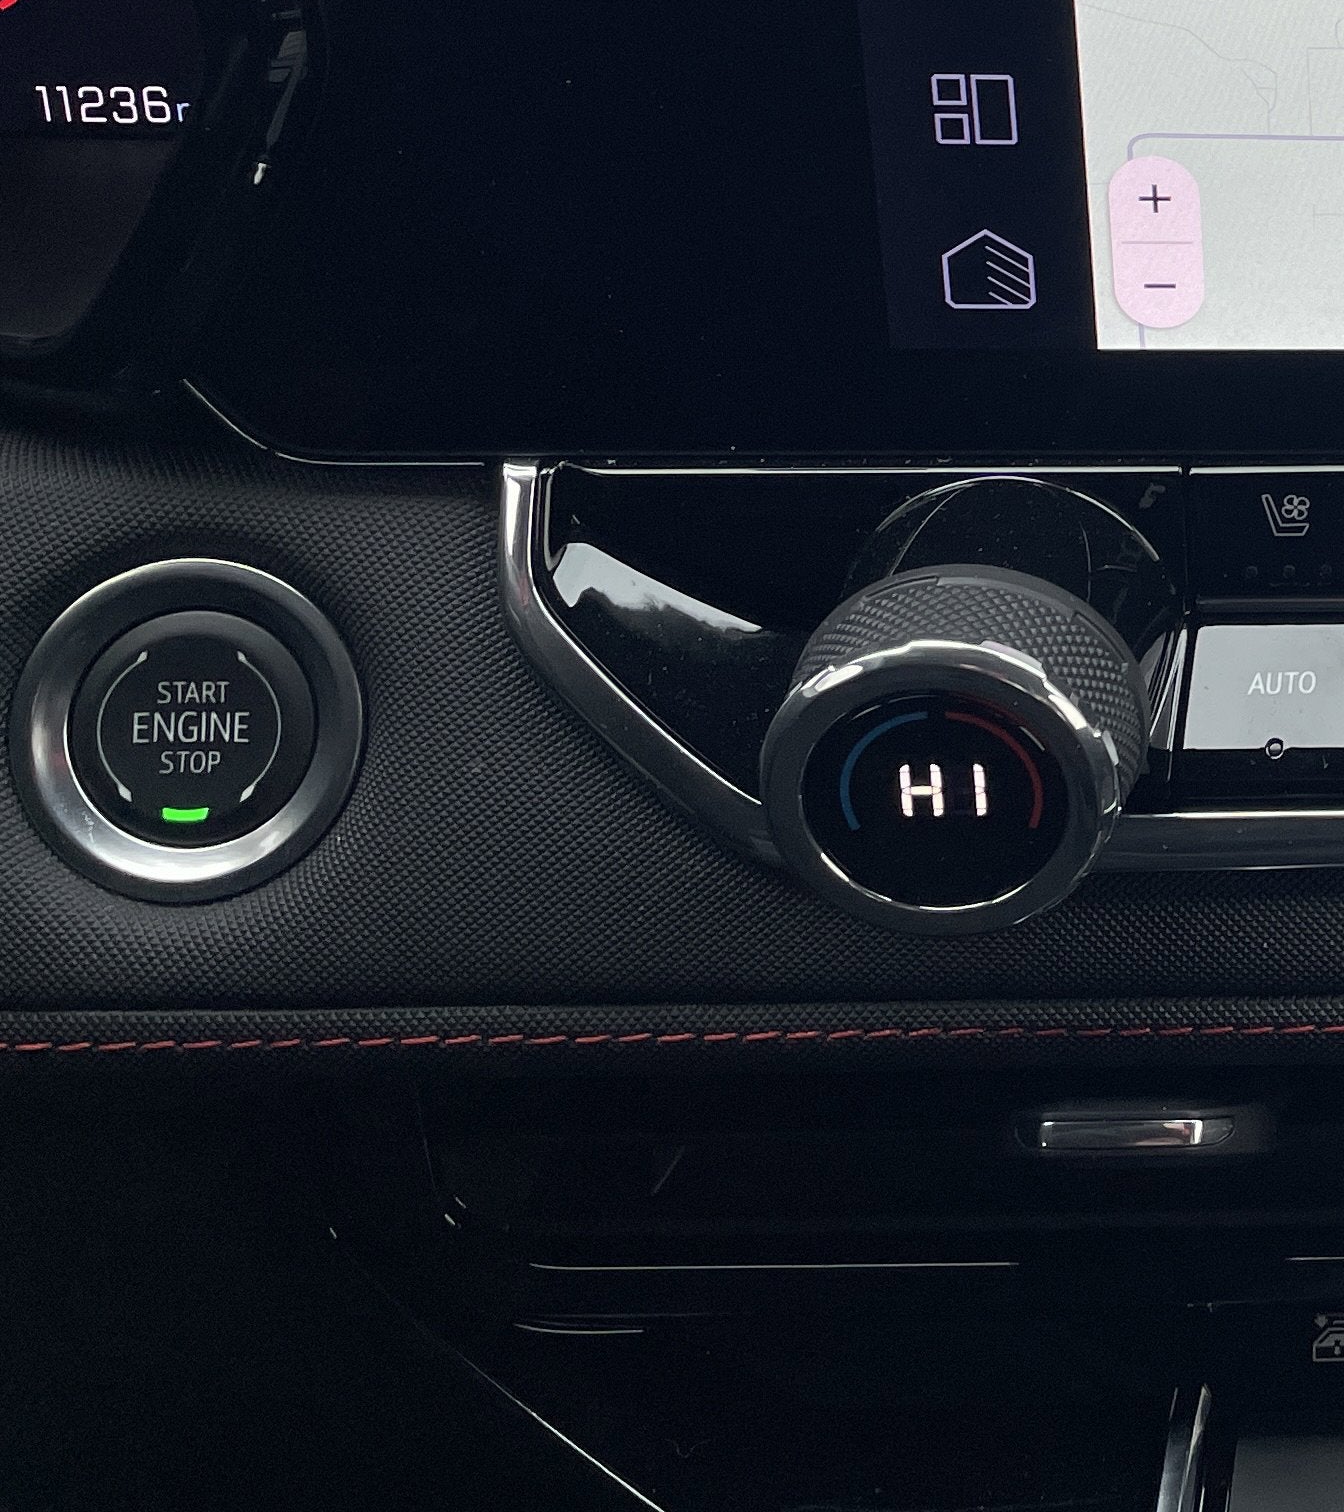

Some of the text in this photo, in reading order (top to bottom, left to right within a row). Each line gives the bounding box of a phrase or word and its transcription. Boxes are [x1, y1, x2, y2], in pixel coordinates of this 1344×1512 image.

[156, 681, 230, 704] START
[1247, 671, 1316, 696] AUTO
[132, 711, 250, 744] ENGINE
[158, 750, 221, 774] STOP
